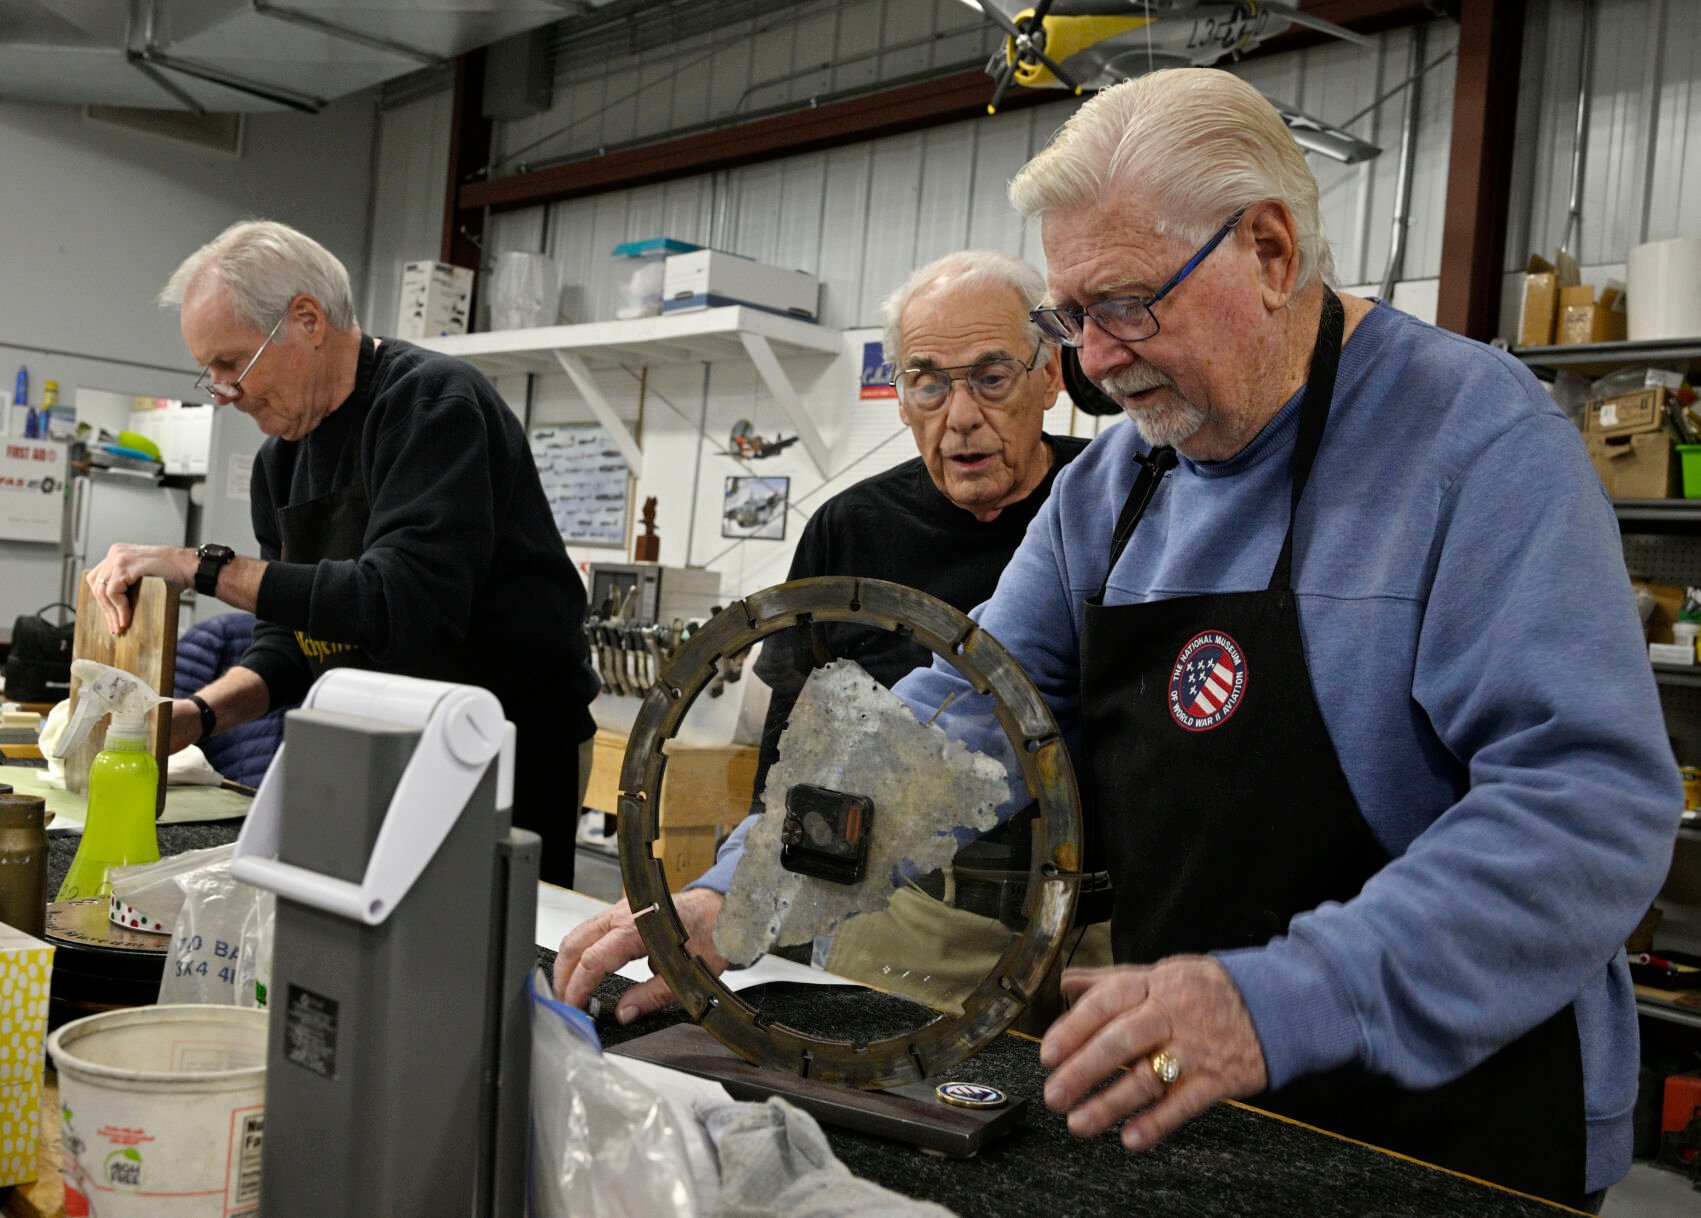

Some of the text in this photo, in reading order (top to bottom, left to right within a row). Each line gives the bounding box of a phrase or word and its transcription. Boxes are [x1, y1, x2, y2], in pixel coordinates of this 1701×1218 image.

[1173, 634, 1242, 682] THE NATIONAL MUSEUM
[1170, 671, 1244, 728] OF WORLD WAR II AVIATION
[214, 940, 240, 961] BA
